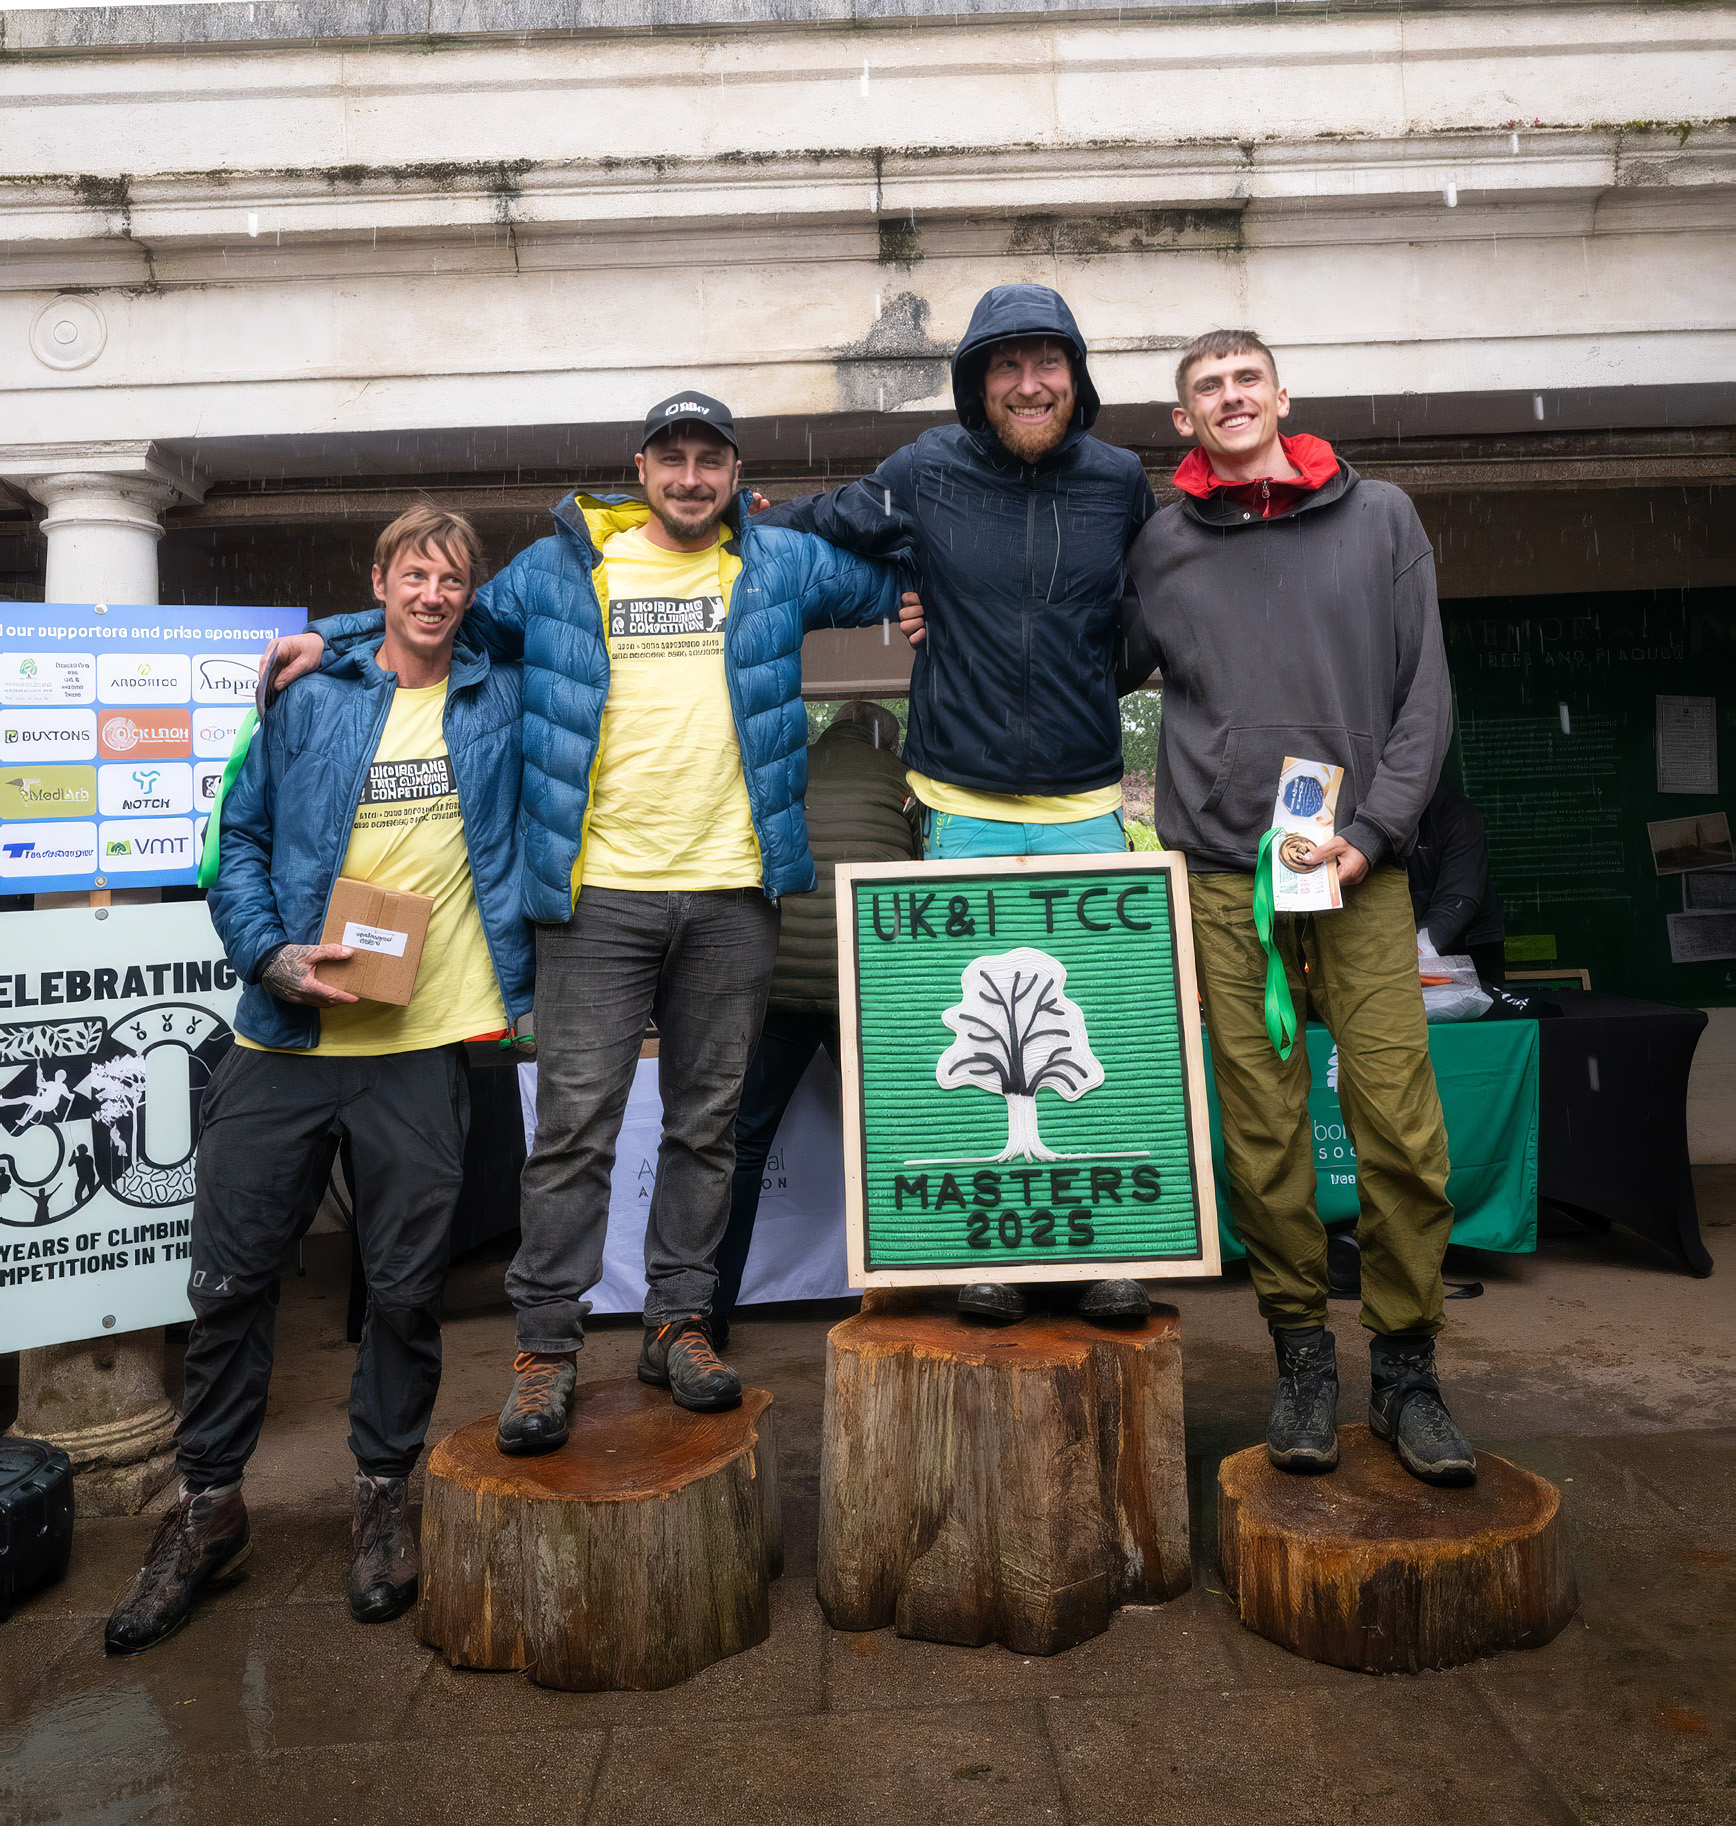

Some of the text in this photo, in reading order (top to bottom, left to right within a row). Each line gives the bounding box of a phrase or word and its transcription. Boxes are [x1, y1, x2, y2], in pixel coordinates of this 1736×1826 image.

[6, 626, 35, 637] our
[1028, 885, 1153, 934] TCC
[894, 1165, 1162, 1211] MASTERS
[75, 1232, 102, 1251] OF
[966, 1209, 1095, 1249] 2025
[134, 1245, 156, 1266] IN
